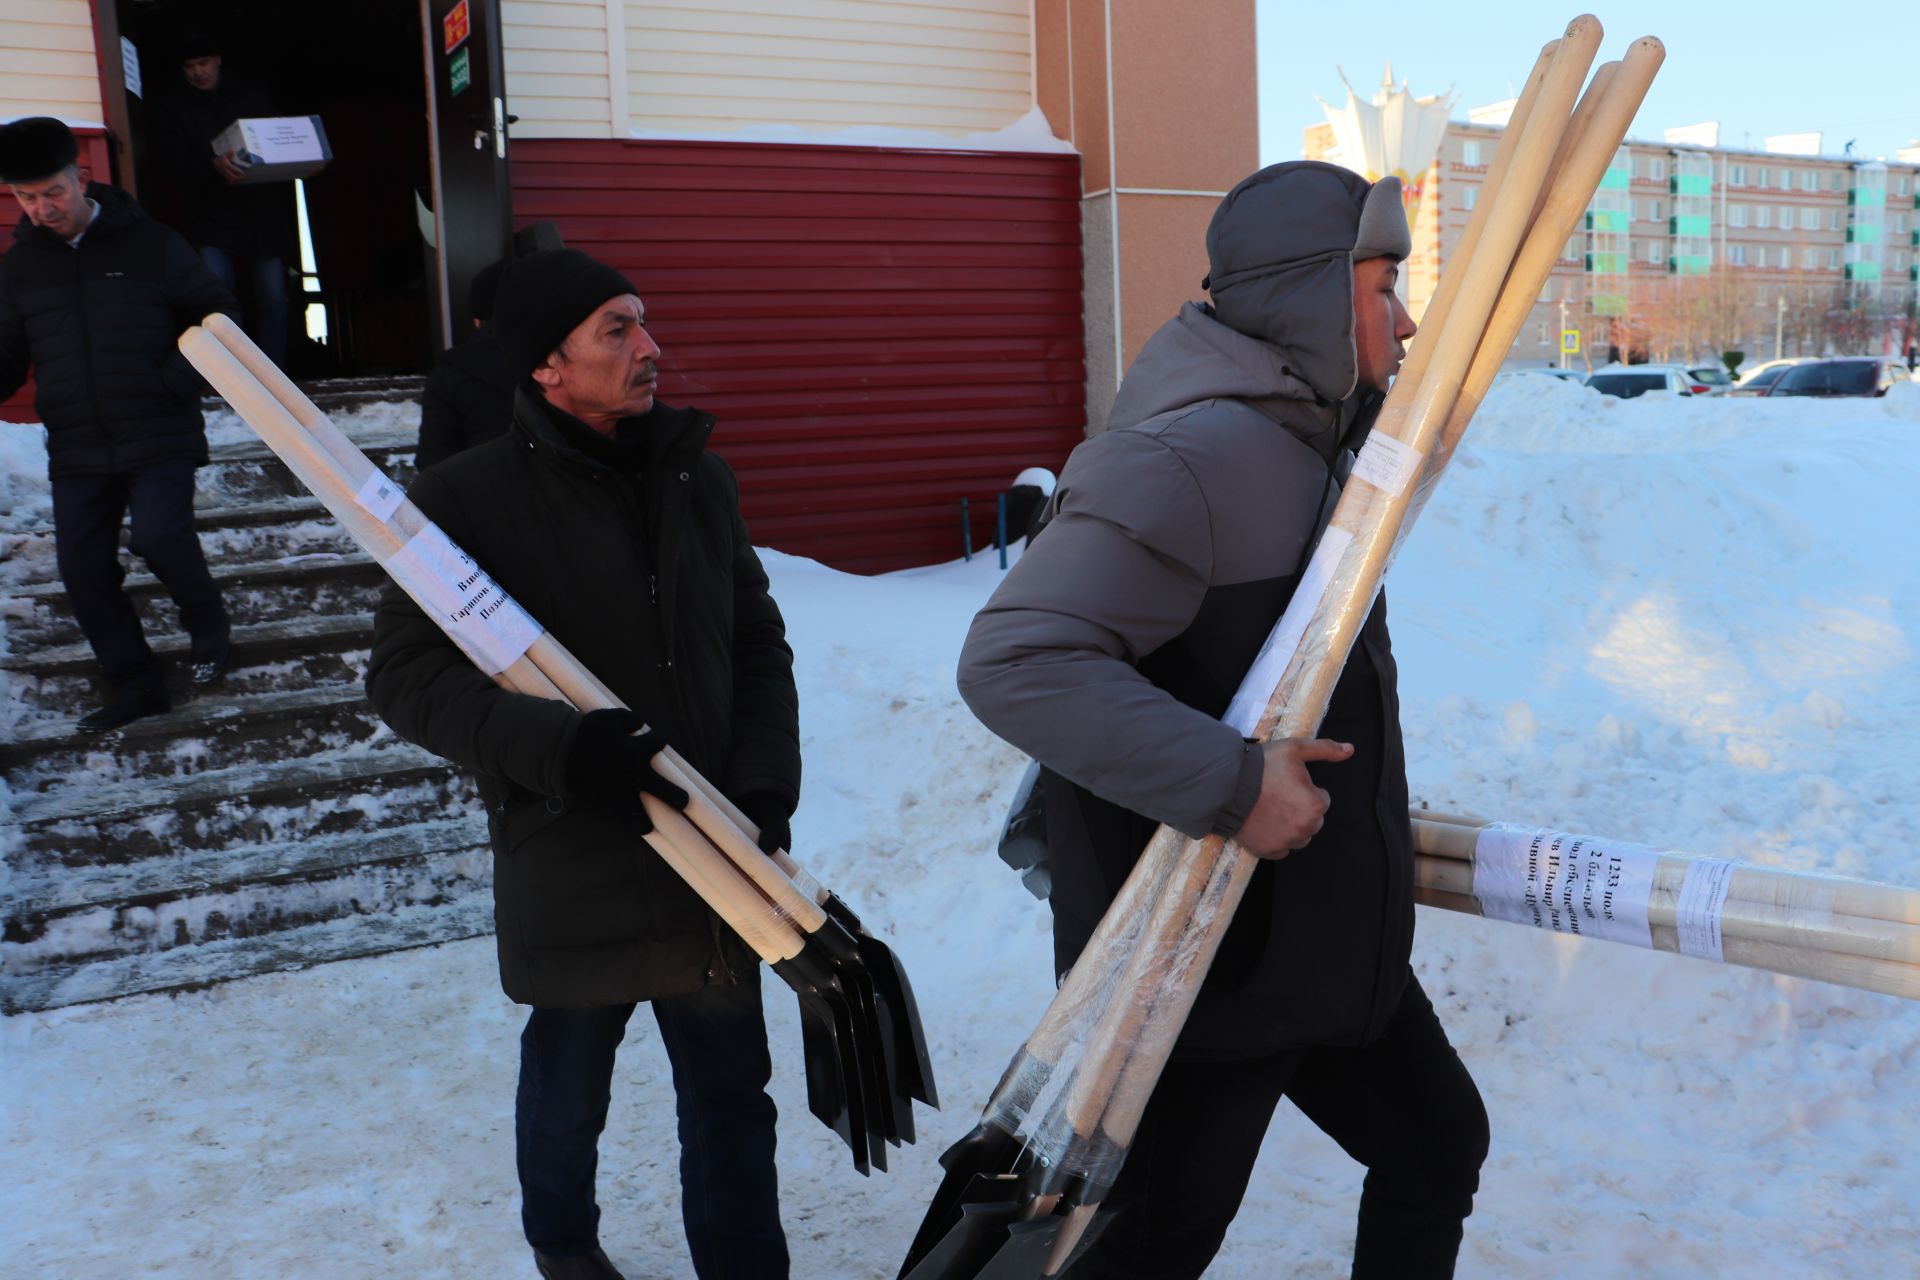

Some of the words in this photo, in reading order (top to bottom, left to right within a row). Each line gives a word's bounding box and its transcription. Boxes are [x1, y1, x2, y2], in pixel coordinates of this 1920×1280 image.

[450, 586, 490, 622] Гарипов
[1551, 837, 1564, 852] ев
[1568, 840, 1583, 860] вод
[1590, 850, 1603, 858] 2
[1542, 855, 1560, 907] Ильвир
[1607, 857, 1622, 888] 1233
[1603, 891, 1615, 921] полк
